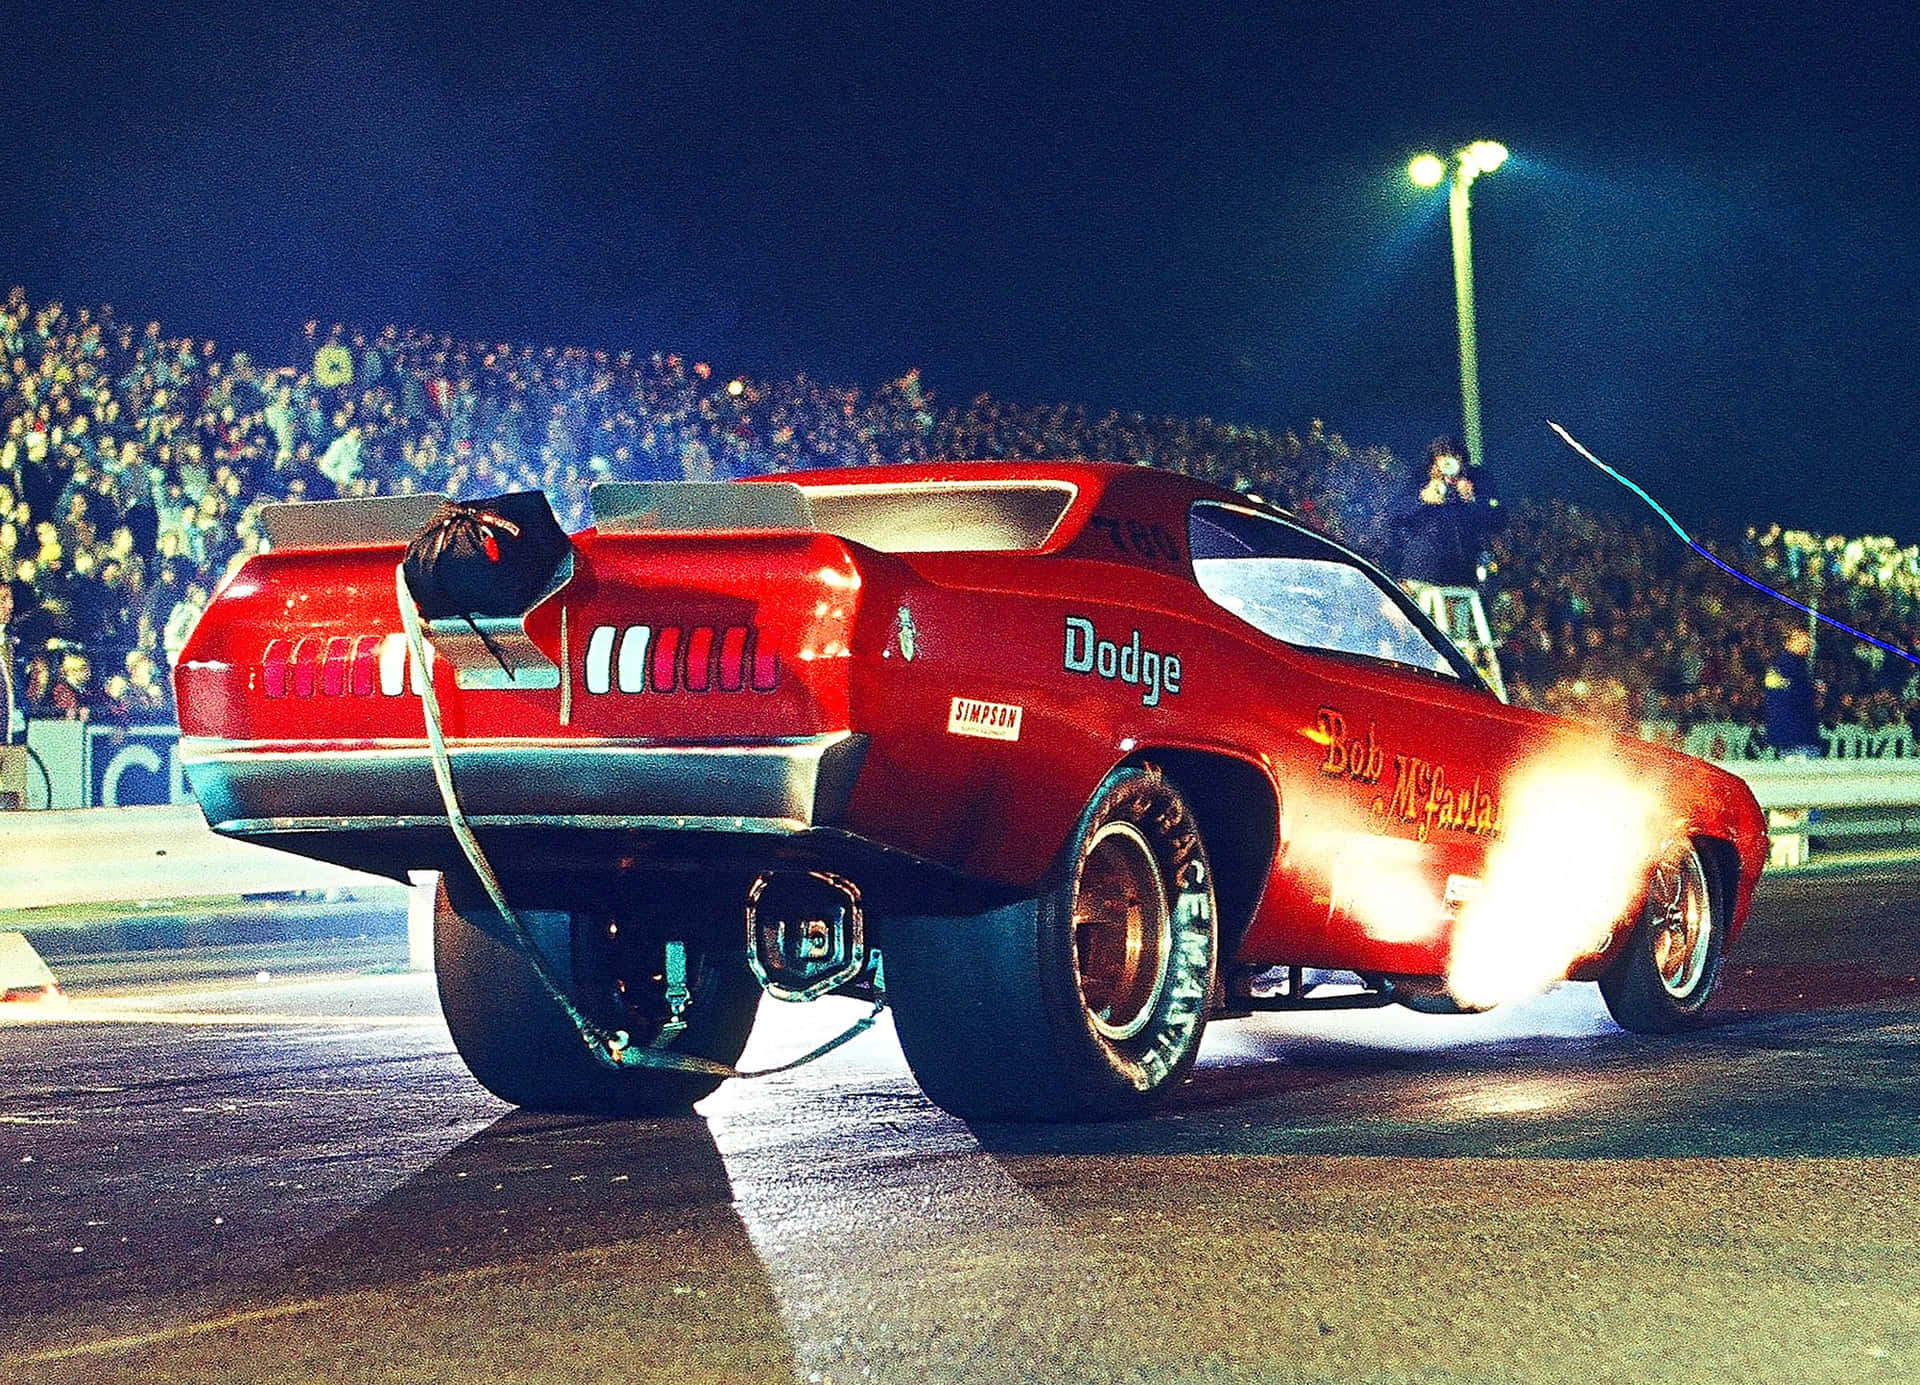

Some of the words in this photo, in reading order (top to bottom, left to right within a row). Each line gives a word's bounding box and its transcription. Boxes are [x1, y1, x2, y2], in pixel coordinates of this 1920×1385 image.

[1064, 616, 1182, 707] Dodge
[955, 701, 1017, 729] SIMPSON
[1310, 705, 1384, 784] Bob
